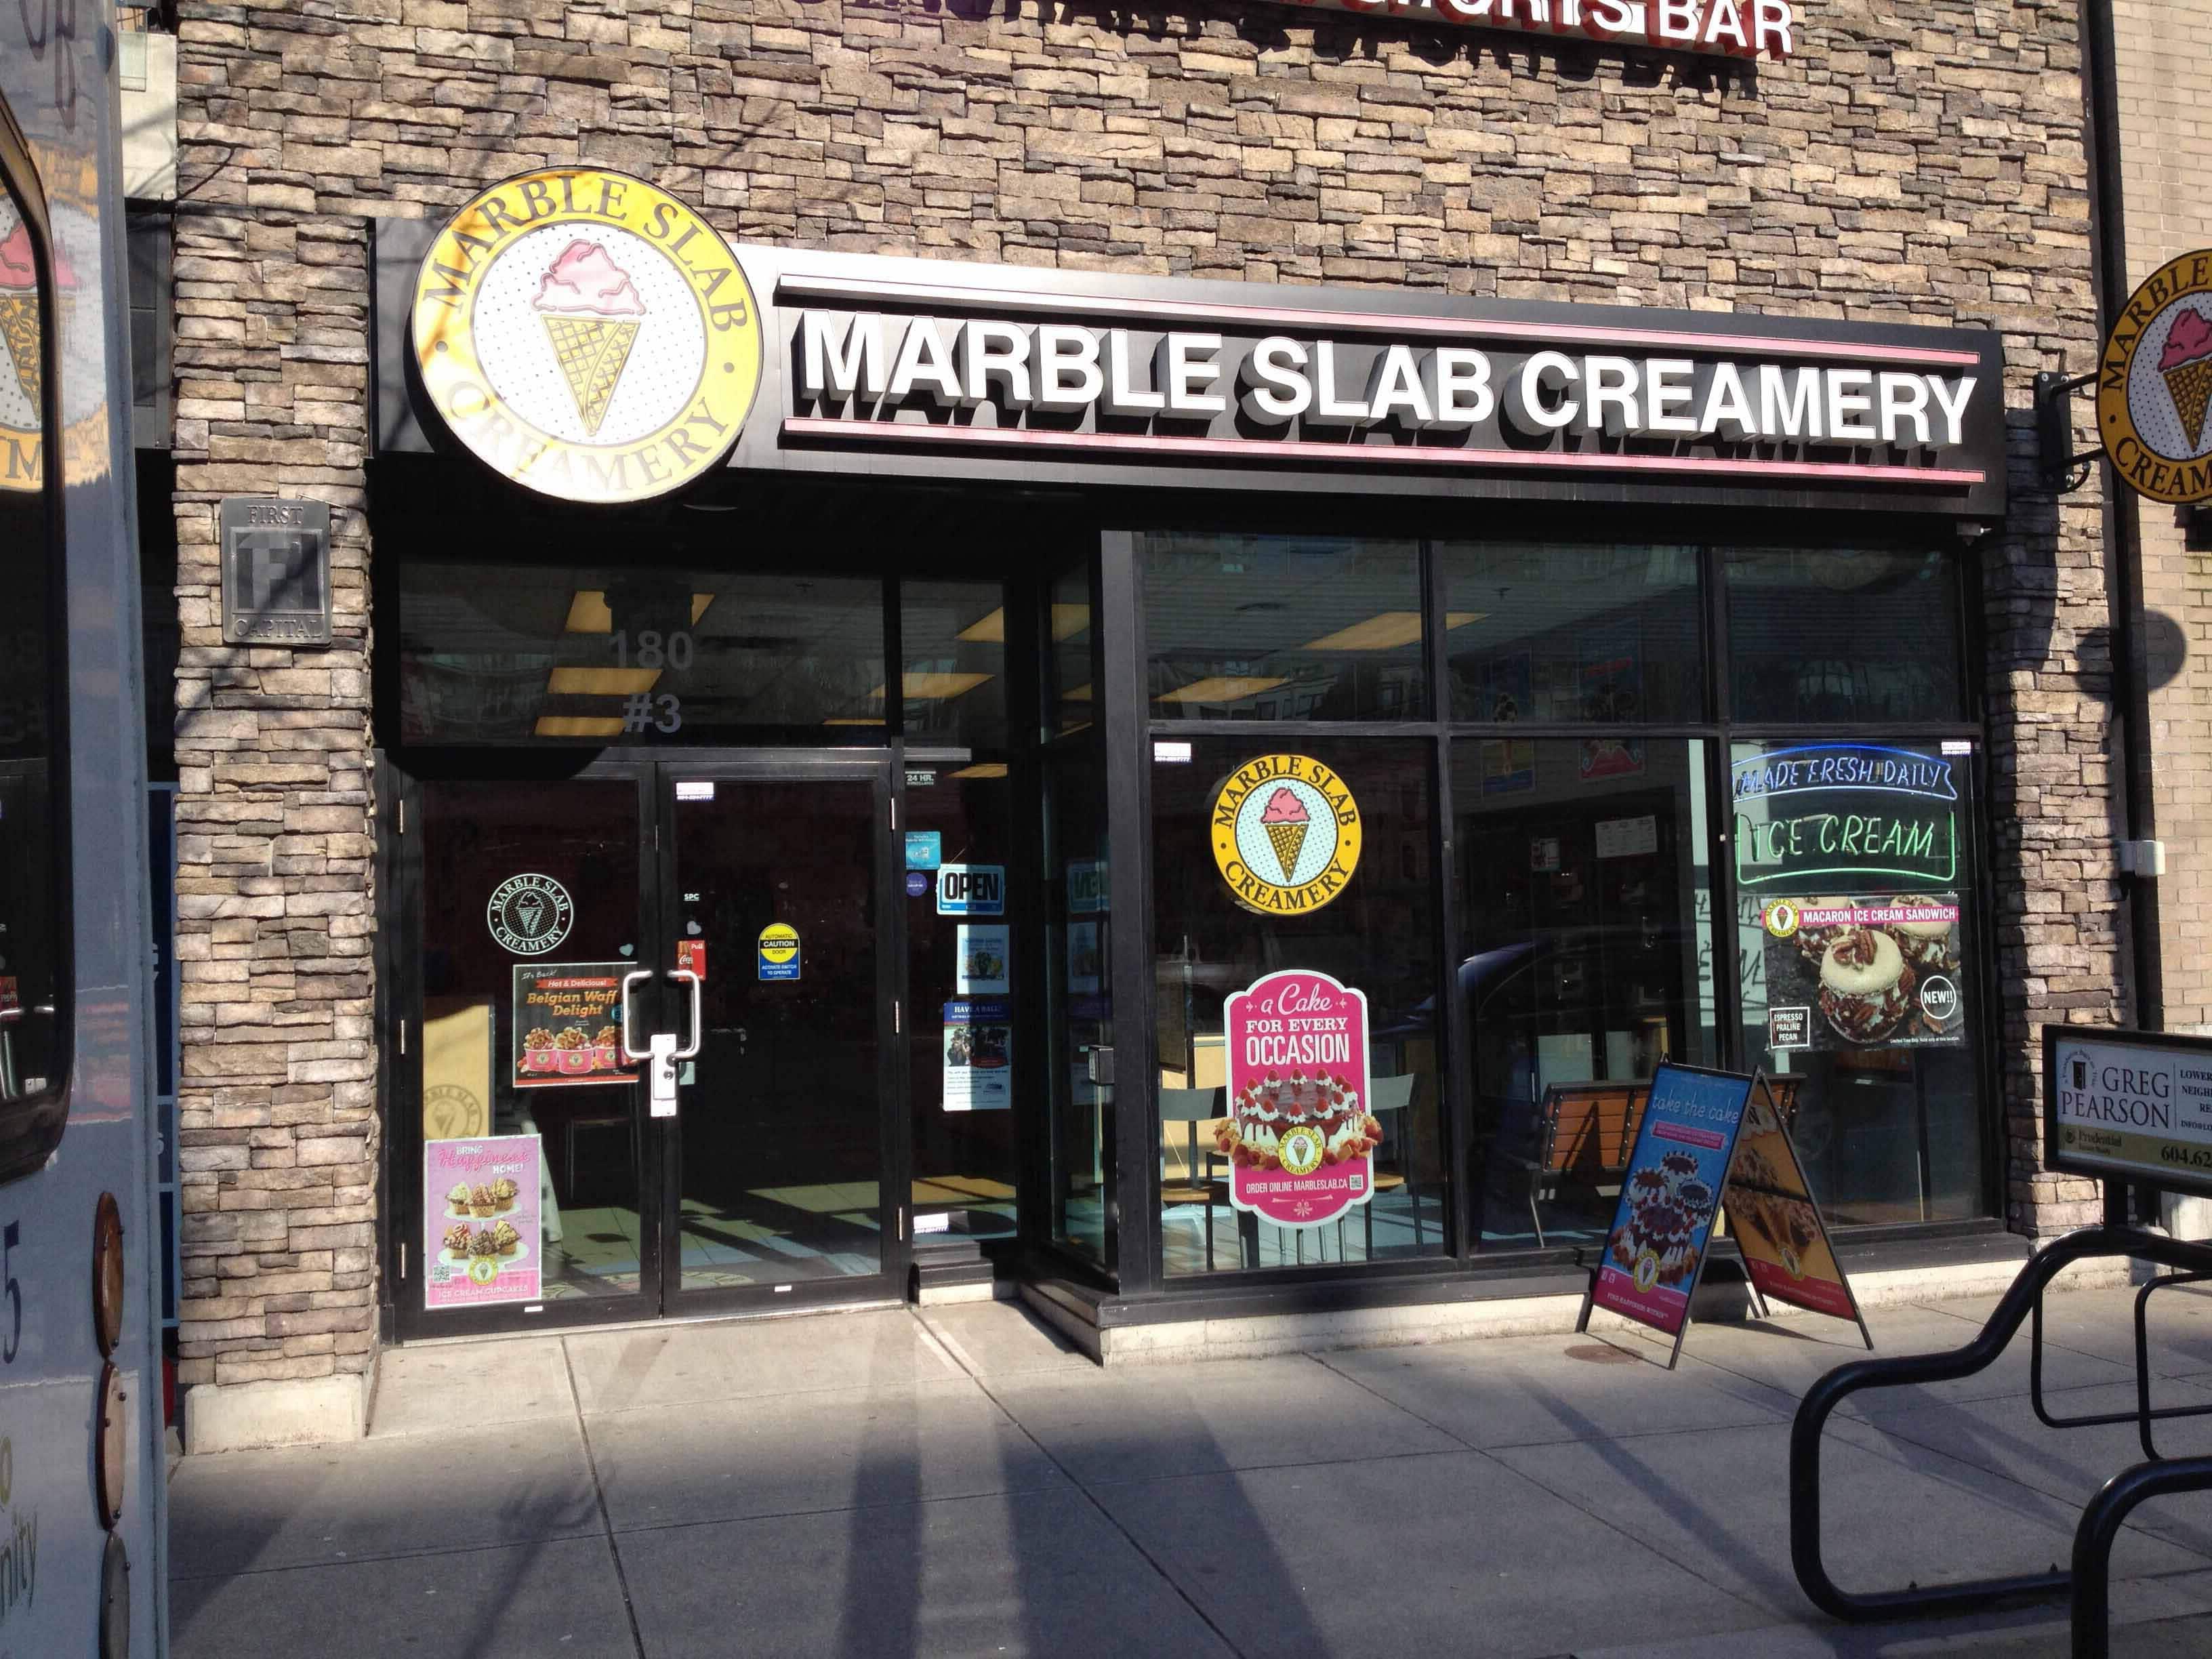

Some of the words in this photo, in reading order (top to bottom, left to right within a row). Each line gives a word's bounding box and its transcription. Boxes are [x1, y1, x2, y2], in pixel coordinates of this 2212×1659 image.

[1660, 0, 1793, 54] BAR
[422, 173, 628, 314] MARBLE
[642, 201, 748, 333] SLAB
[2102, 256, 2209, 392] MARBLE
[802, 309, 1226, 415] MARBLE
[1251, 335, 1494, 424] SLAB
[1520, 350, 1977, 445] CREAMERY
[444, 380, 729, 491] CREAMERY
[247, 505, 304, 525] FIRST
[609, 629, 694, 671] 180
[623, 693, 682, 733] #3
[1736, 762, 1800, 796] MADE
[1809, 757, 1874, 783] FRESH
[1884, 760, 1940, 787] DAILY
[1215, 756, 1302, 830] MARBLE
[1308, 765, 1356, 827] SLAB
[1751, 818, 1803, 862] ICE
[1820, 815, 1935, 858] CREAM
[491, 876, 541, 912] MARBLE
[543, 880, 569, 912] SLAB
[945, 872, 999, 901] OPEN
[1225, 860, 1349, 910] CREAMERY
[1803, 909, 1852, 923] MACARON
[1853, 909, 1869, 922] ICE
[1871, 909, 1904, 922] CREAM
[1906, 907, 1956, 921] SANDWICH
[495, 926, 564, 951] CREAMERY
[527, 991, 581, 1006] Belgian
[583, 989, 619, 1004] Waff
[548, 980, 560, 988] Hot
[571, 979, 607, 987] Delicious!
[1923, 990, 1954, 1004] NEW!!
[552, 1004, 603, 1018] Delight
[1261, 998, 1274, 1015] a
[1277, 983, 1333, 1015] Cake
[1246, 1019, 1284, 1033] FOR
[1288, 1017, 1349, 1032] EVERY
[1774, 1013, 1803, 1022] ESPRESSO
[1776, 1023, 1801, 1032] PRALINE
[1246, 1033, 1350, 1066] OCCASION
[1778, 1033, 1797, 1042] PECAN
[2102, 1066, 2169, 1098] GREG
[1653, 1088, 1681, 1113] take
[1685, 1090, 1706, 1118] the
[1708, 1097, 1740, 1124] cake
[2060, 1090, 2170, 1130] PEARSON
[455, 1145, 483, 1155] BRING
[2078, 1129, 2123, 1147] Prudential
[493, 1163, 524, 1174] HOME!
[1246, 1182, 1268, 1194] ORDER
[1269, 1180, 1292, 1192] ONLINE
[1293, 1178, 1348, 1191] MARBLESLAB.CA
[438, 1290, 453, 1298] ICE
[454, 1288, 483, 1298] CREAM
